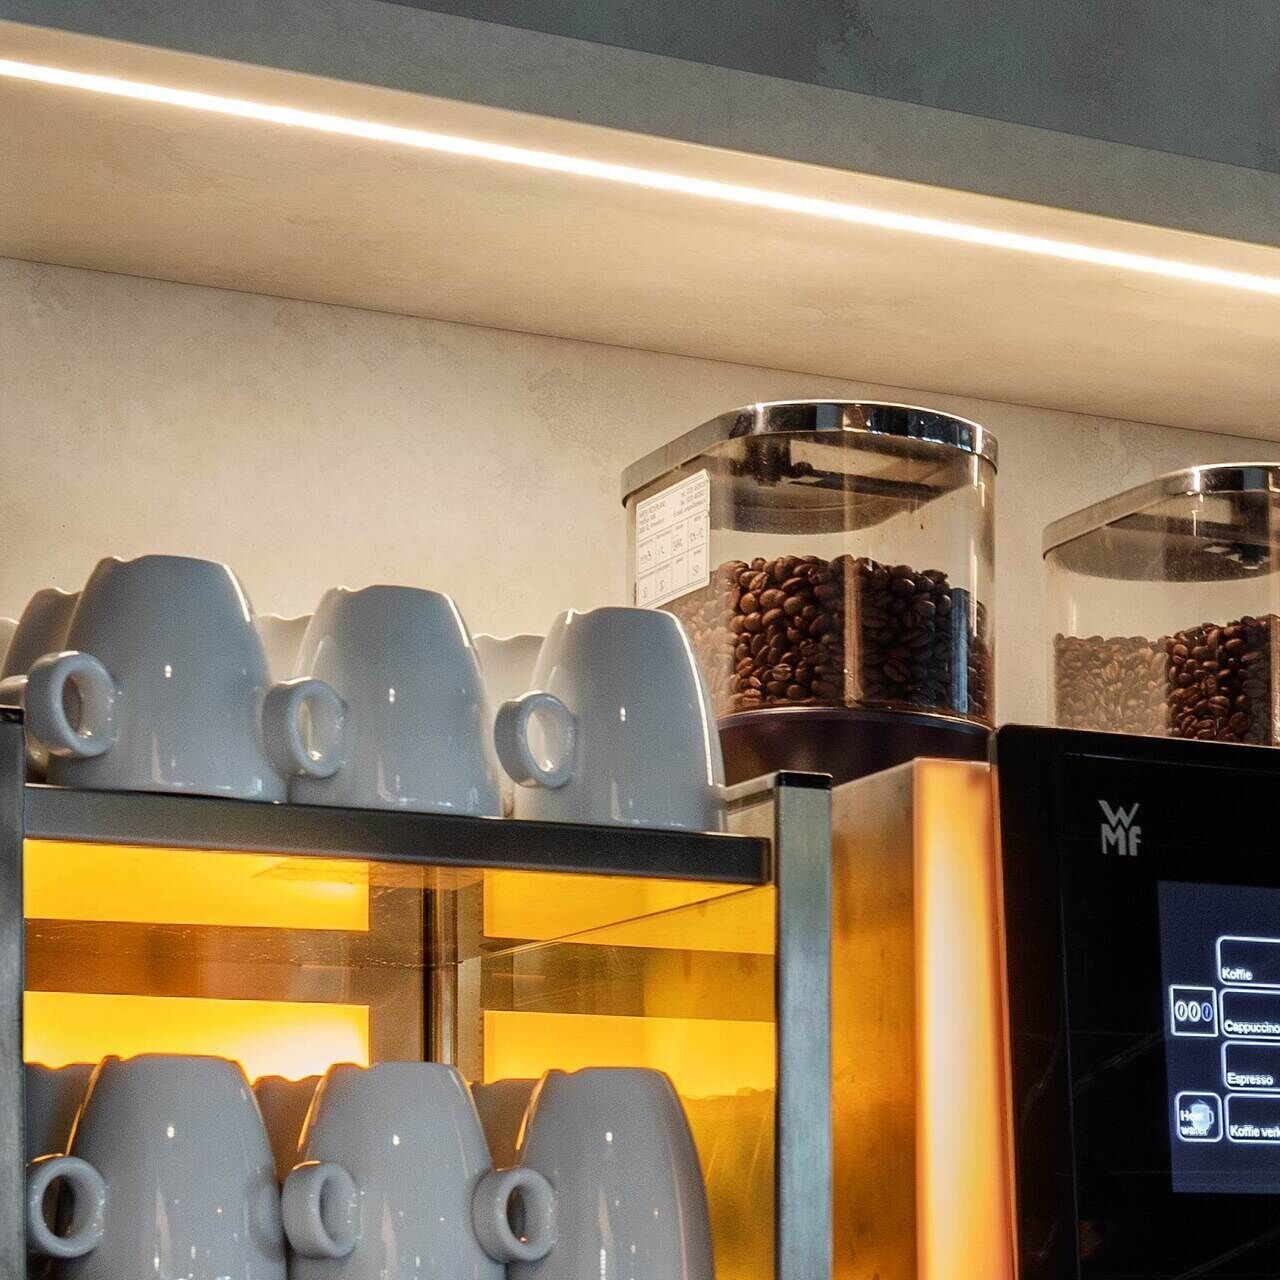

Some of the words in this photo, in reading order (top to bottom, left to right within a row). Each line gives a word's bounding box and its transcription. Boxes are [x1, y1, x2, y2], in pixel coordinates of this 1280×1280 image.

[1222, 967, 1253, 981] Koffie
[1227, 1072, 1274, 1086] Espresso
[1230, 1125, 1260, 1138] Koffie
